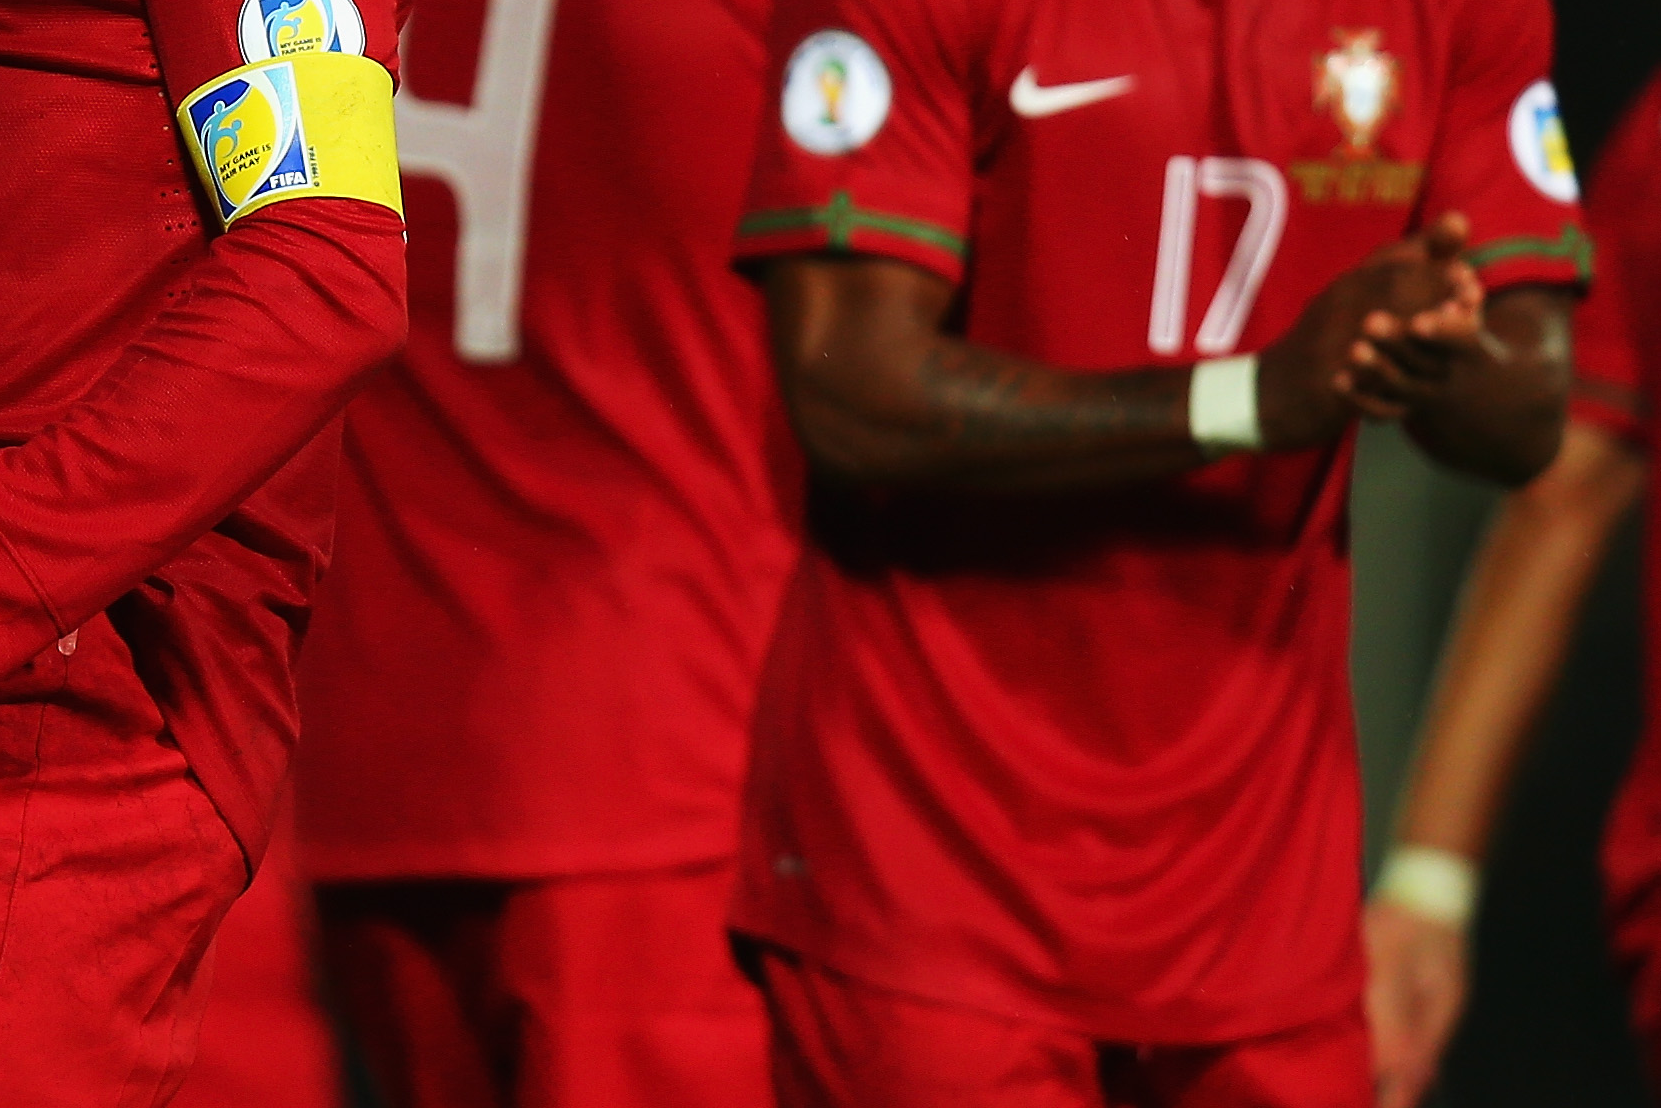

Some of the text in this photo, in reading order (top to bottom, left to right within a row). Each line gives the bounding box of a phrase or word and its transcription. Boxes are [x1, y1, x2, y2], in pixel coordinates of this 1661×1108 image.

[219, 144, 272, 173] MY GAME IS
[221, 156, 261, 183] FAIR PLAY
[269, 171, 307, 189] FIFA
[1148, 154, 1290, 356] 17
